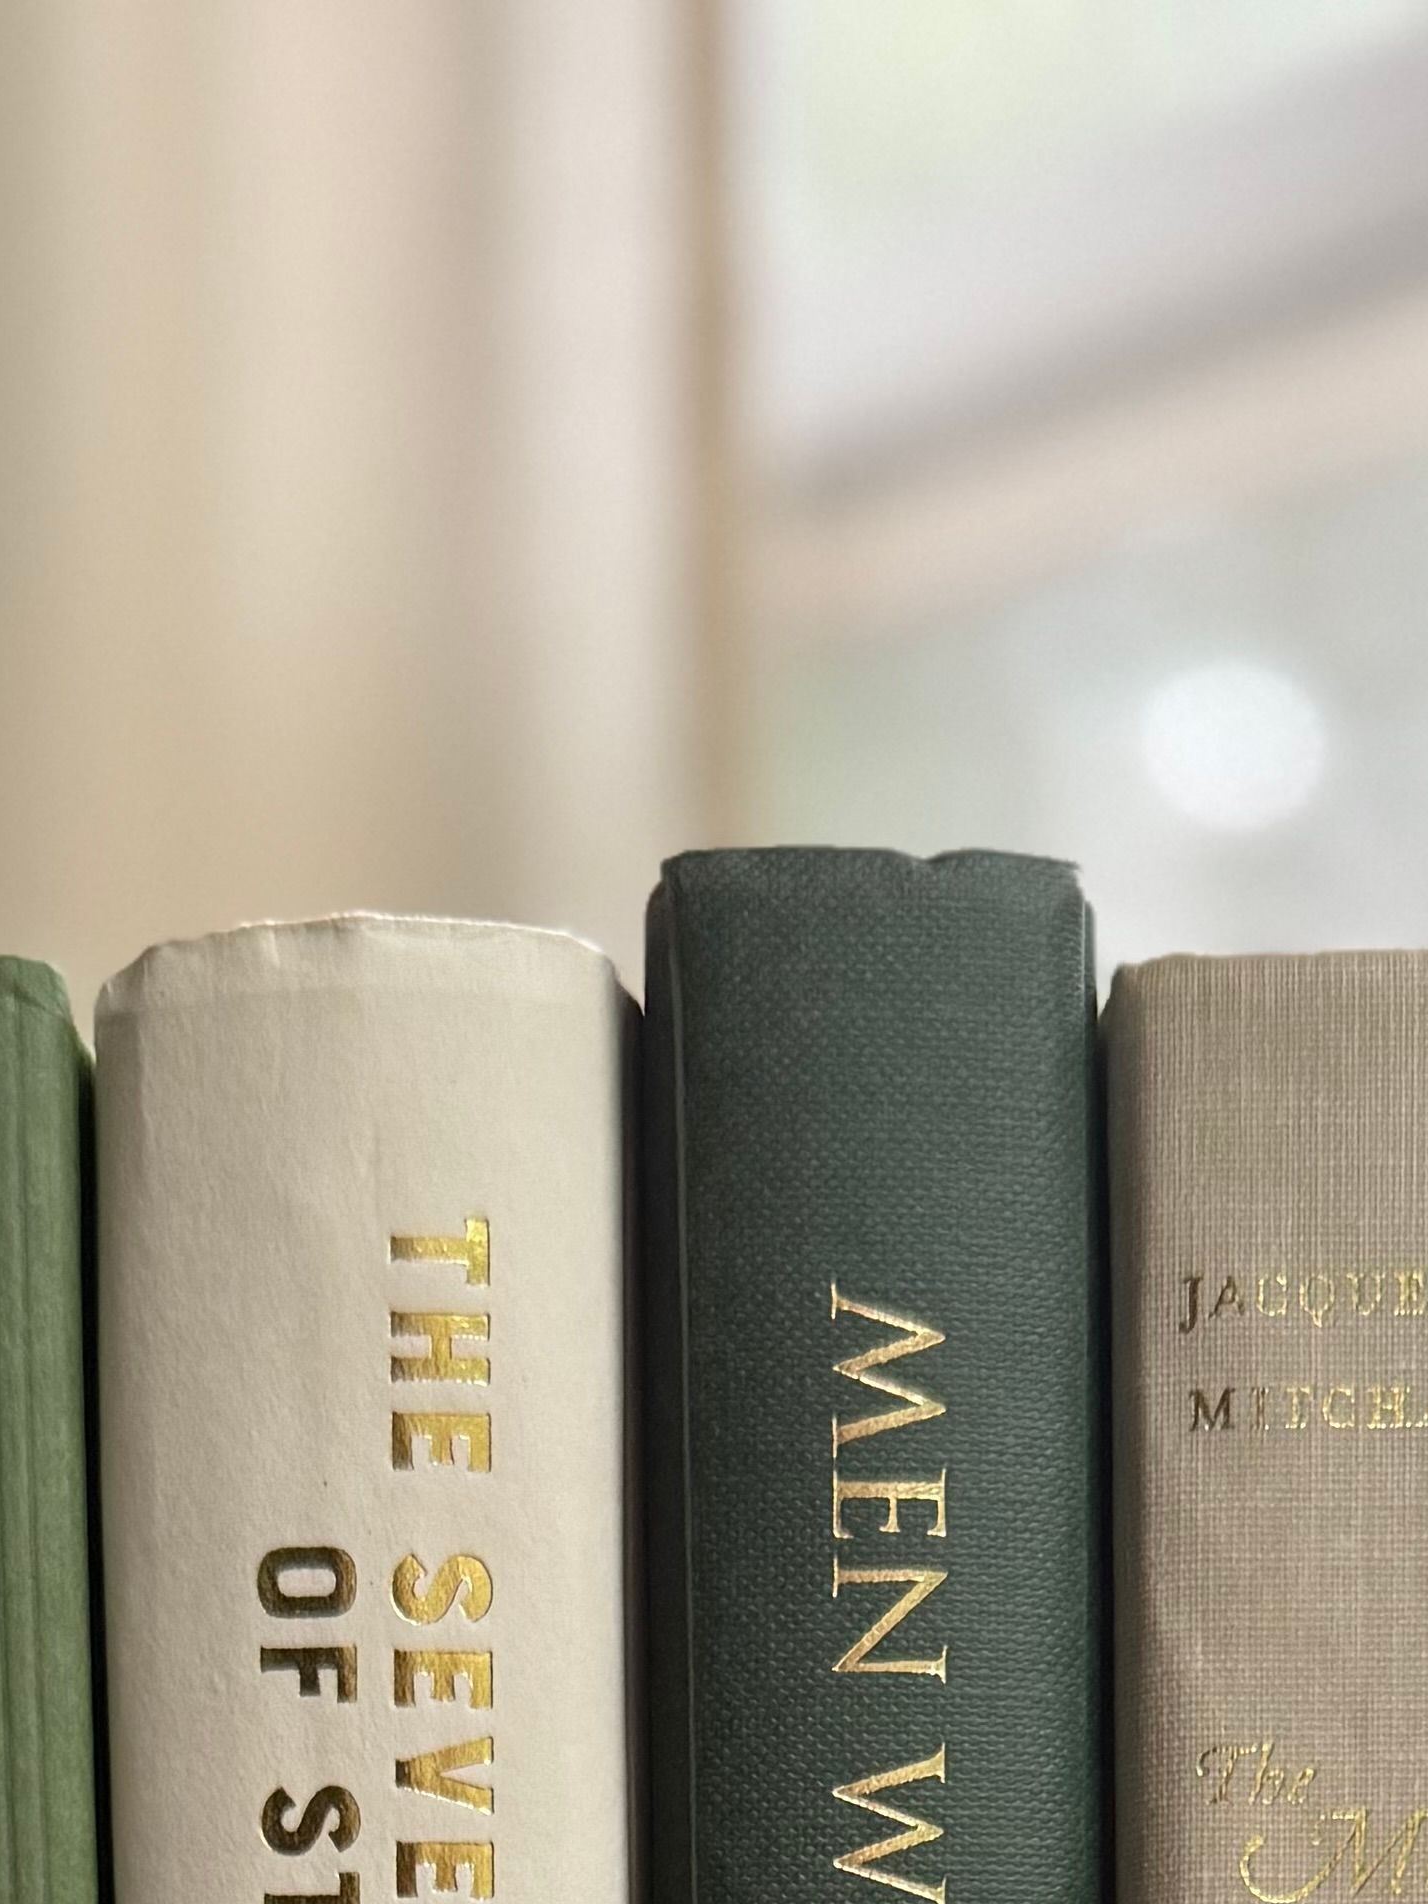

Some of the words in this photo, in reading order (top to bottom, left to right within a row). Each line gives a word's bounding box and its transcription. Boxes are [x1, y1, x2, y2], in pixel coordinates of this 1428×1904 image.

[388, 1217, 492, 1473] THE
[830, 1277, 949, 1686] MEN
[256, 1545, 359, 1705] OF
[1194, 1740, 1318, 1806] The
